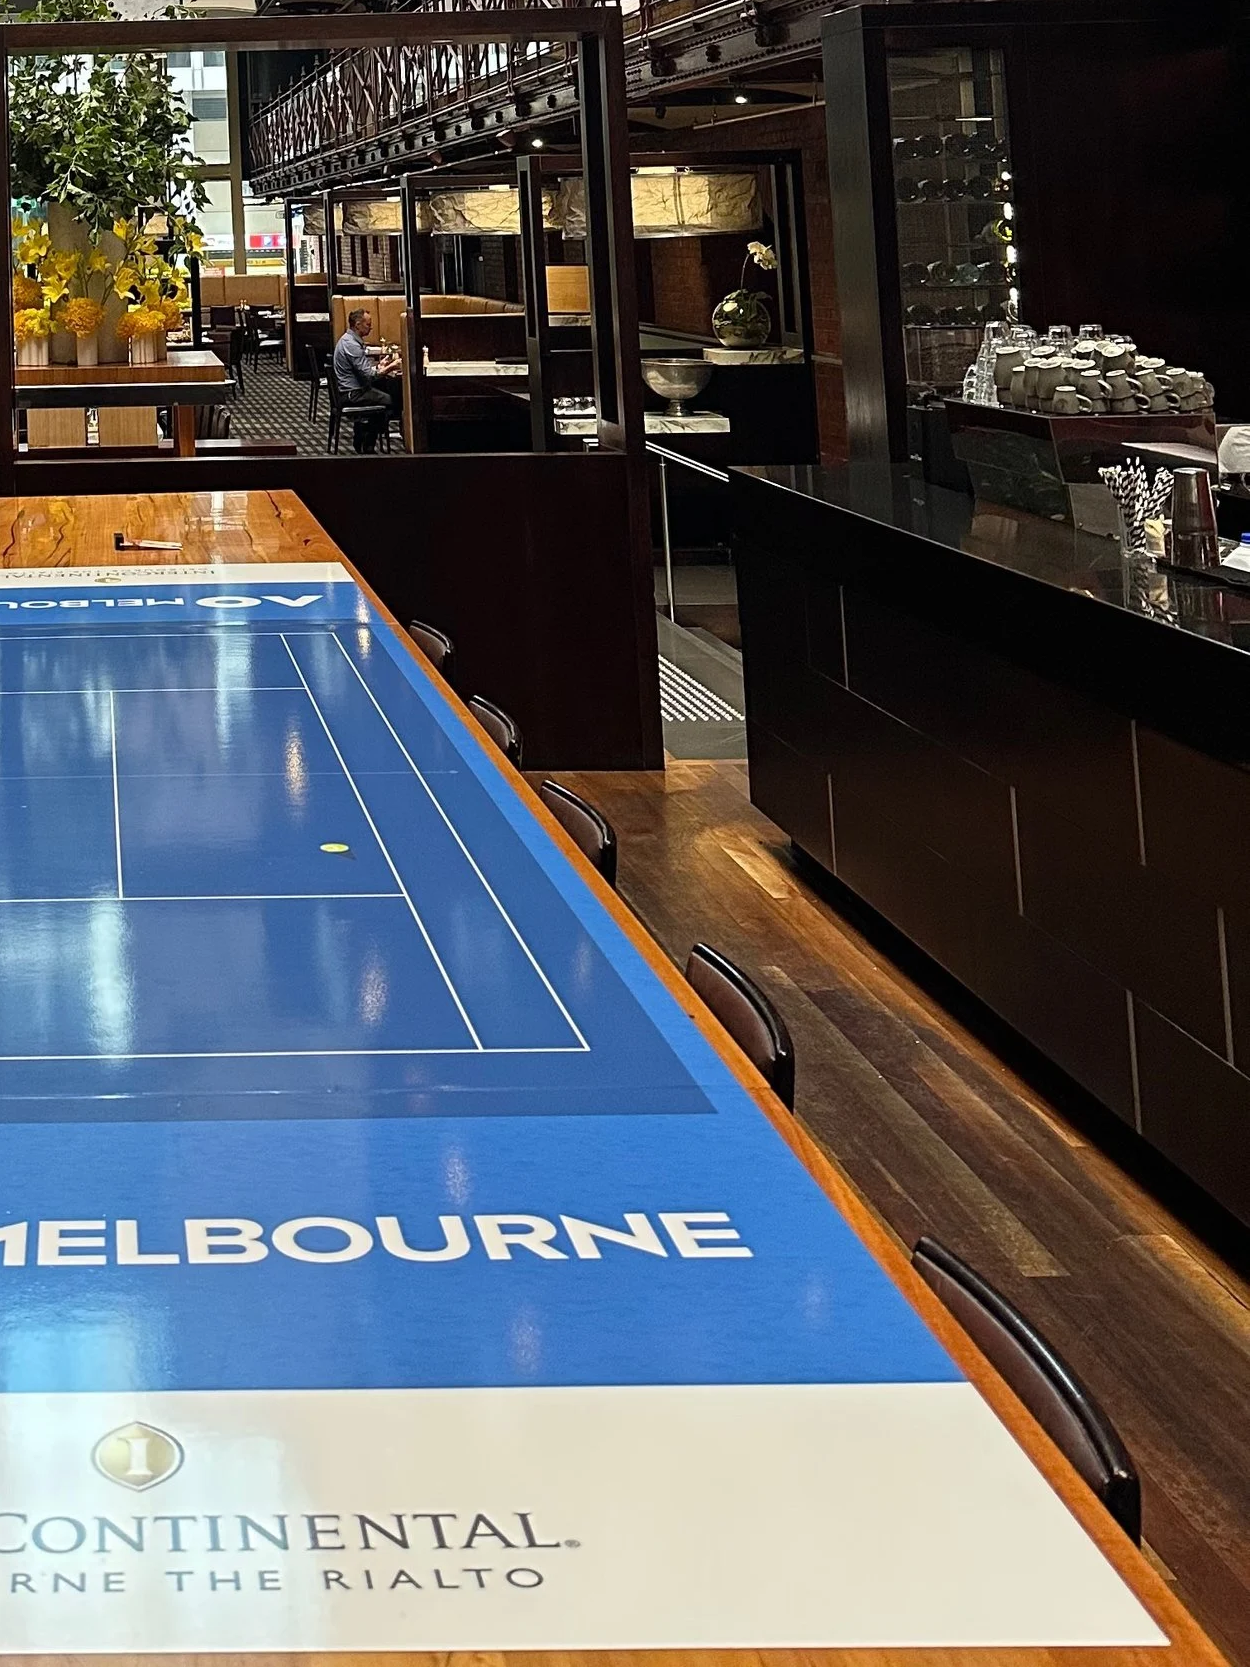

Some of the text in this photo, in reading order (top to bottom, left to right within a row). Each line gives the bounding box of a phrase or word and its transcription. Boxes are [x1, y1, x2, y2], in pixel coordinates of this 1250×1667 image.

[195, 594, 324, 609] AO
[165, 1567, 284, 1592] THE
[323, 1566, 545, 1591] RIALTO
